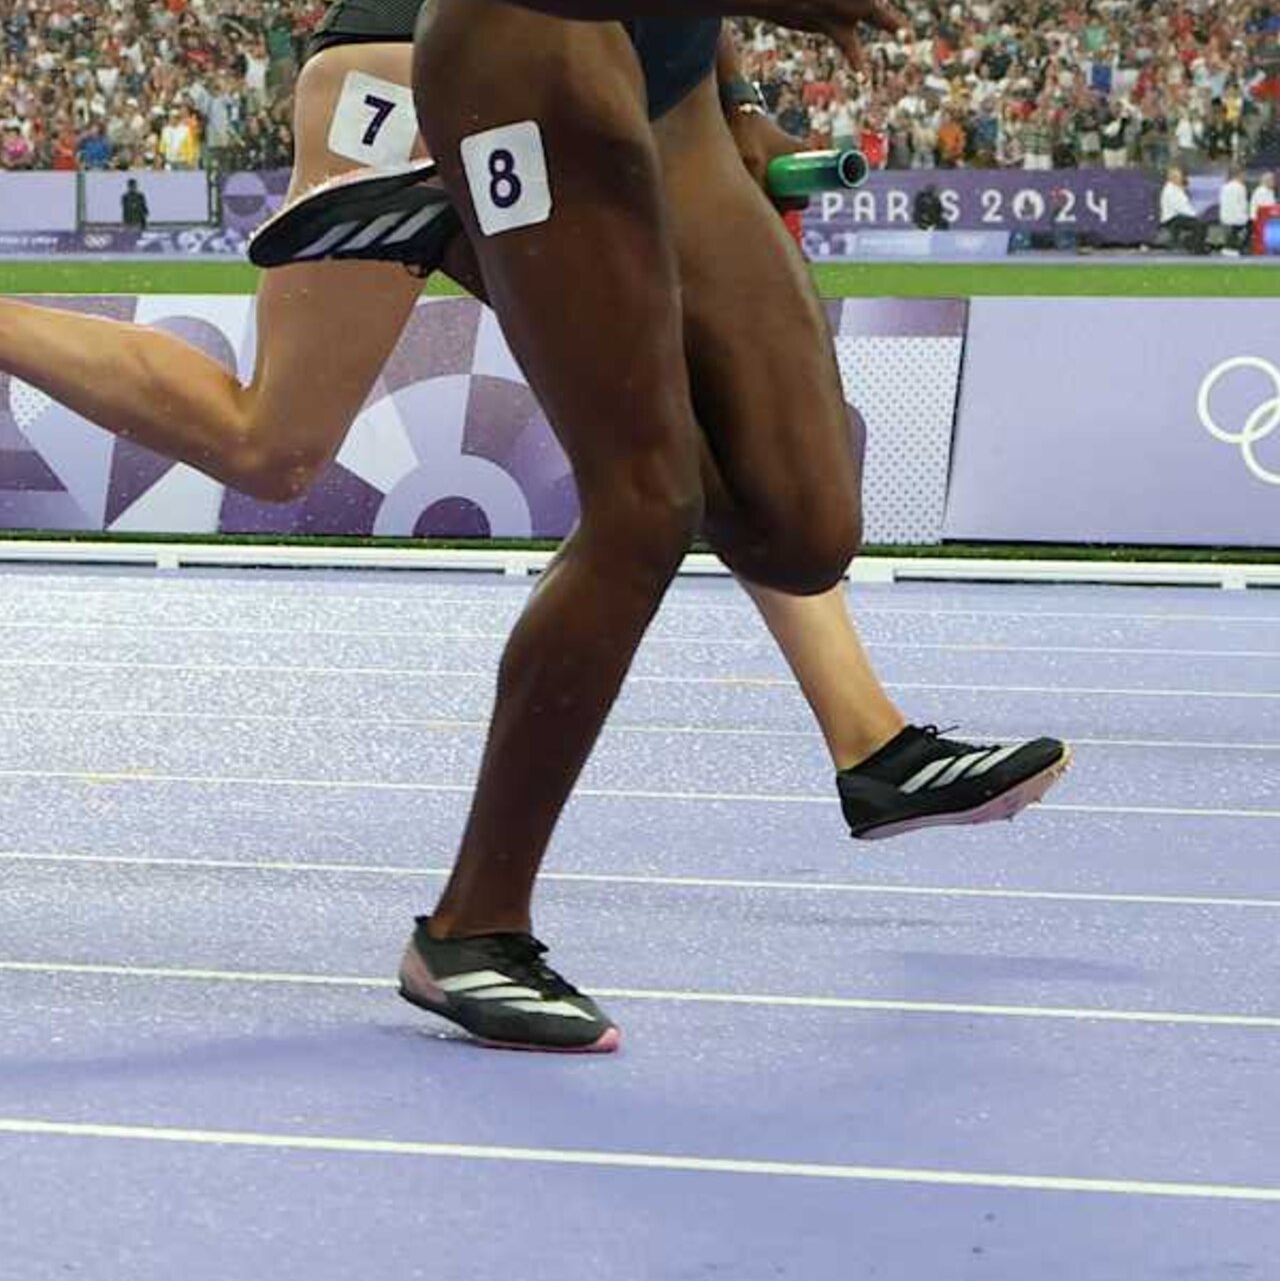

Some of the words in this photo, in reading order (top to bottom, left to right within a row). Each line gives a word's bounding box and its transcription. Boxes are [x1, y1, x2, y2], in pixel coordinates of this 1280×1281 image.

[362, 94, 396, 146] 7
[488, 149, 521, 209] 8
[821, 190, 959, 221] PARS
[981, 189, 1108, 221] 2024
